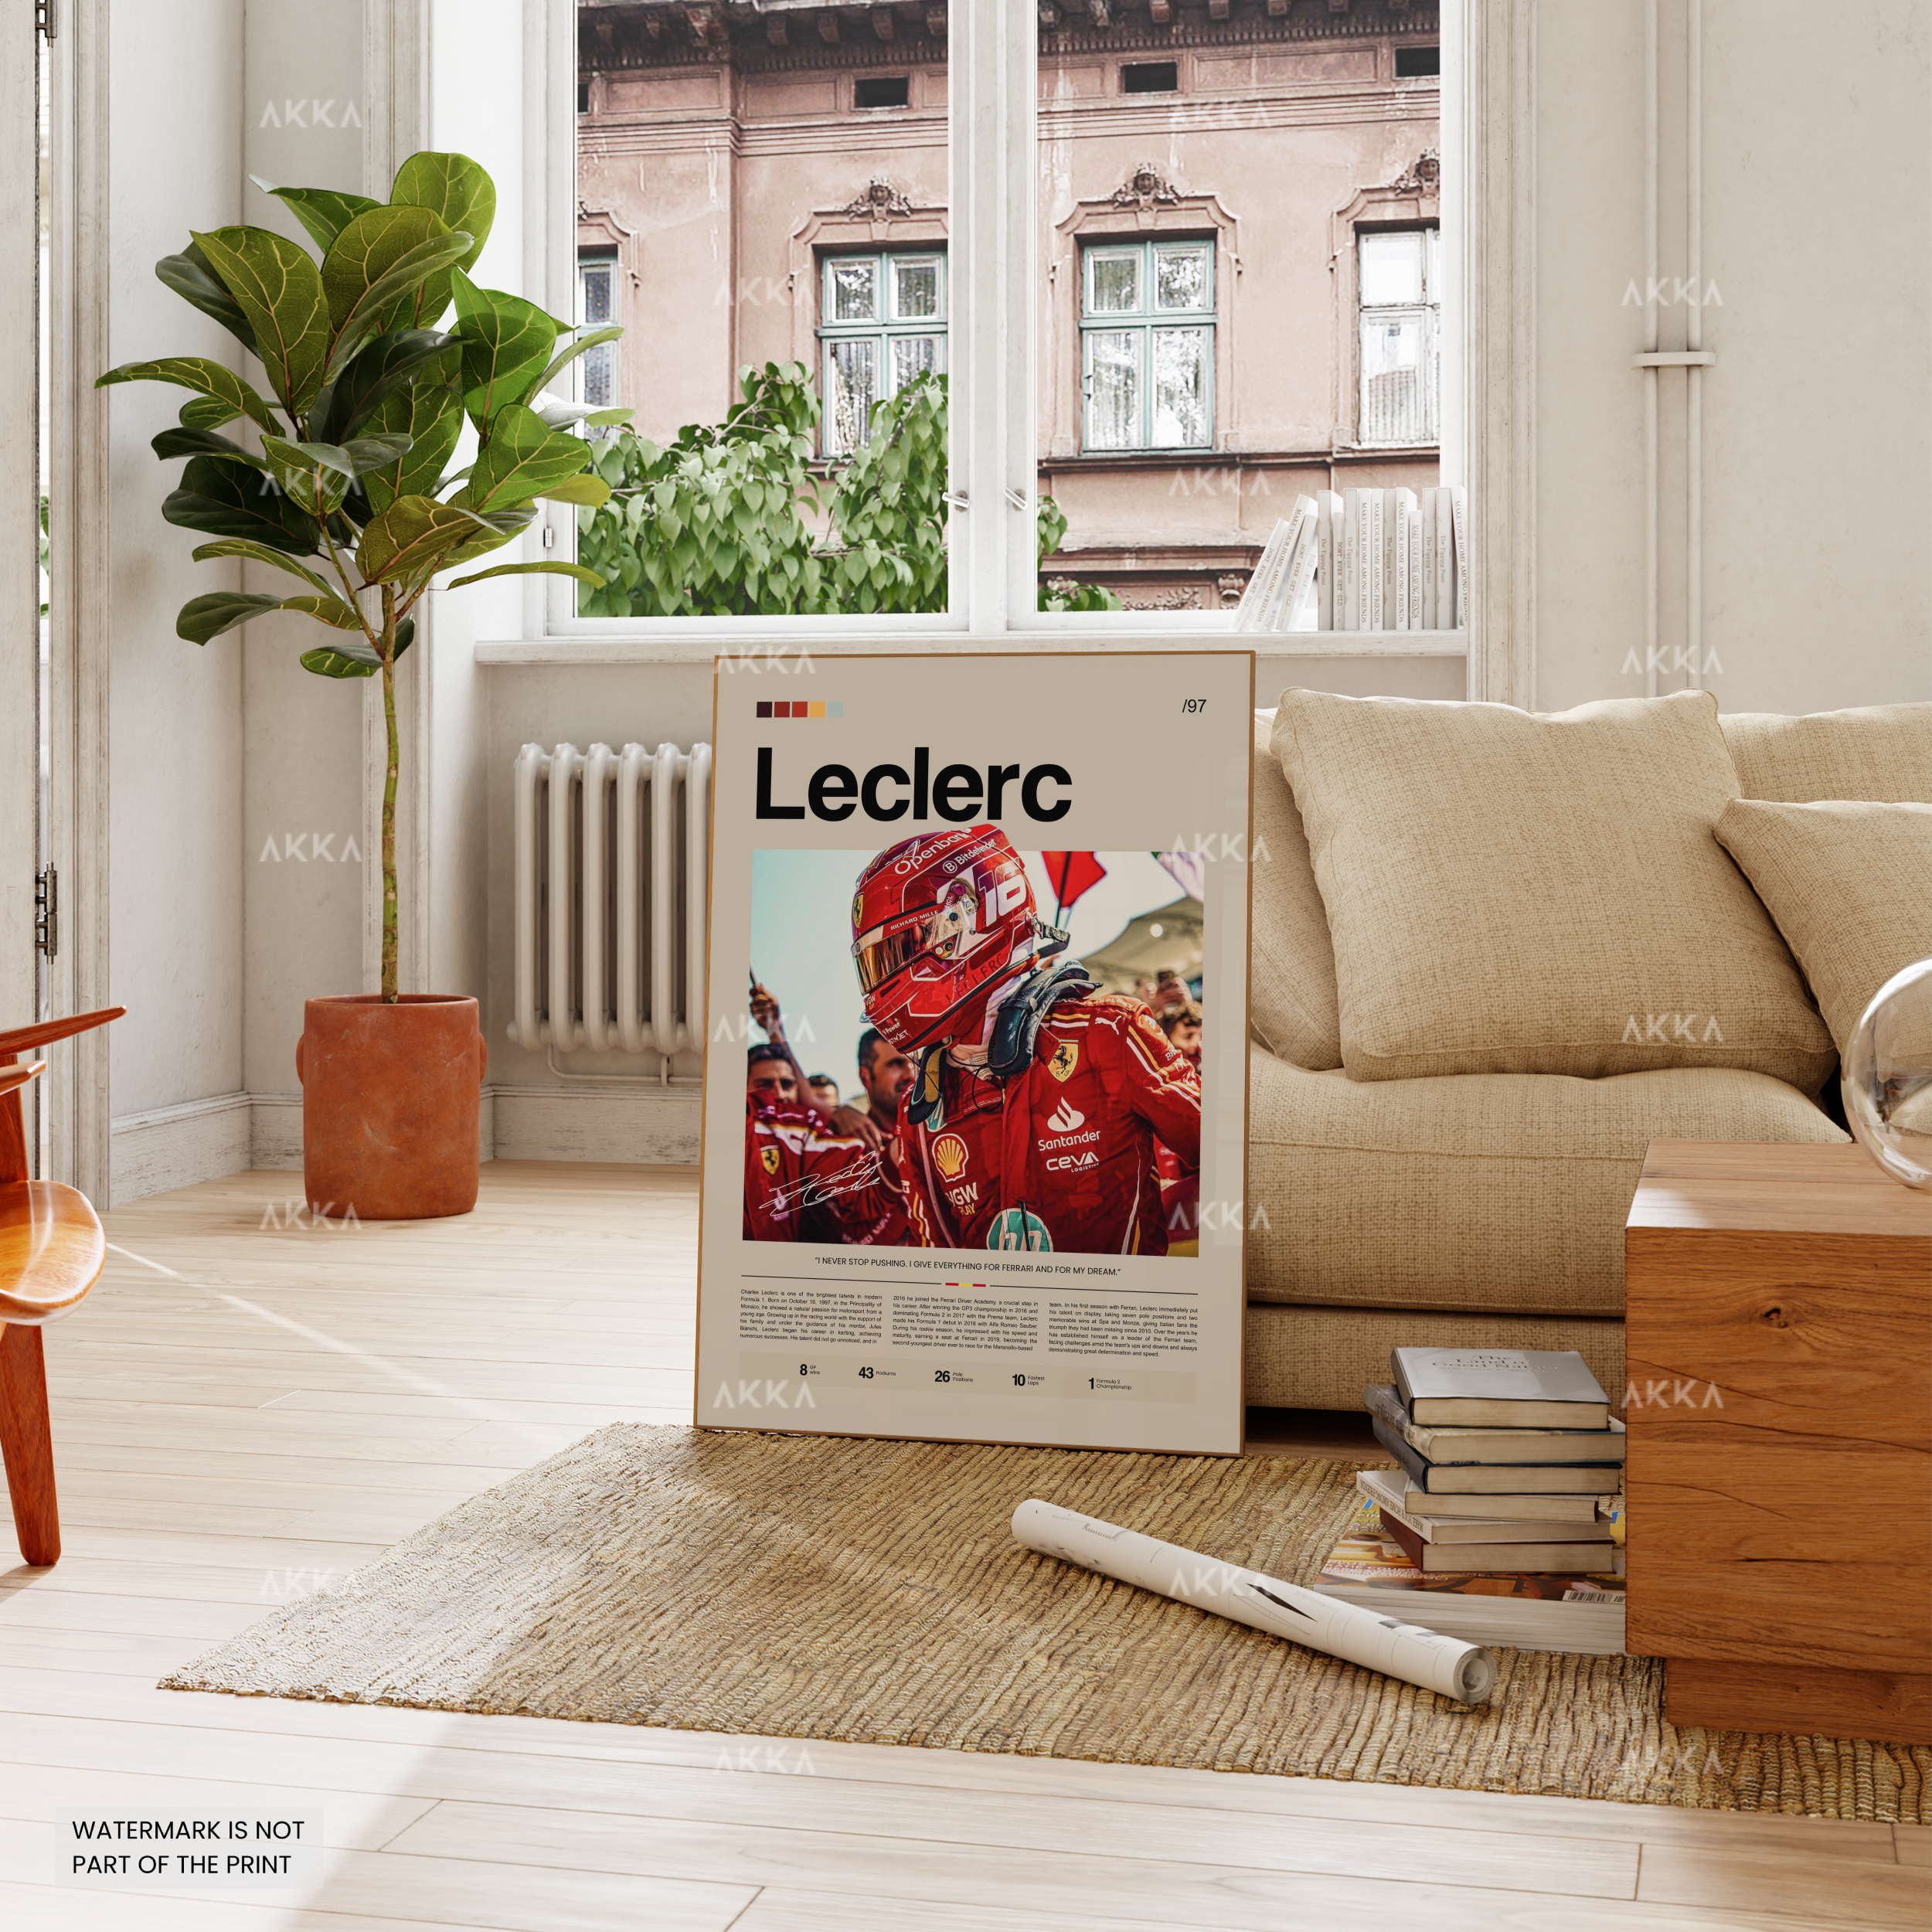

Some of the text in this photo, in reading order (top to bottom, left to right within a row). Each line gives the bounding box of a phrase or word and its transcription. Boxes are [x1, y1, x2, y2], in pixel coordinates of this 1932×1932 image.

[1182, 699, 1207, 713] /97
[756, 747, 1072, 822] Leclerc
[954, 838, 996, 865] Bitdefender
[978, 862, 1026, 927] 16
[890, 910, 939, 930] RICHARD MILLE
[1038, 1131, 1100, 1151] Santander
[934, 1261, 981, 1270] EVERYTHING
[800, 1364, 808, 1376] 8
[859, 1367, 874, 1379] 43
[934, 1370, 951, 1383] 26
[1012, 1374, 1026, 1386] 10
[1089, 1378, 1094, 1389] 1
